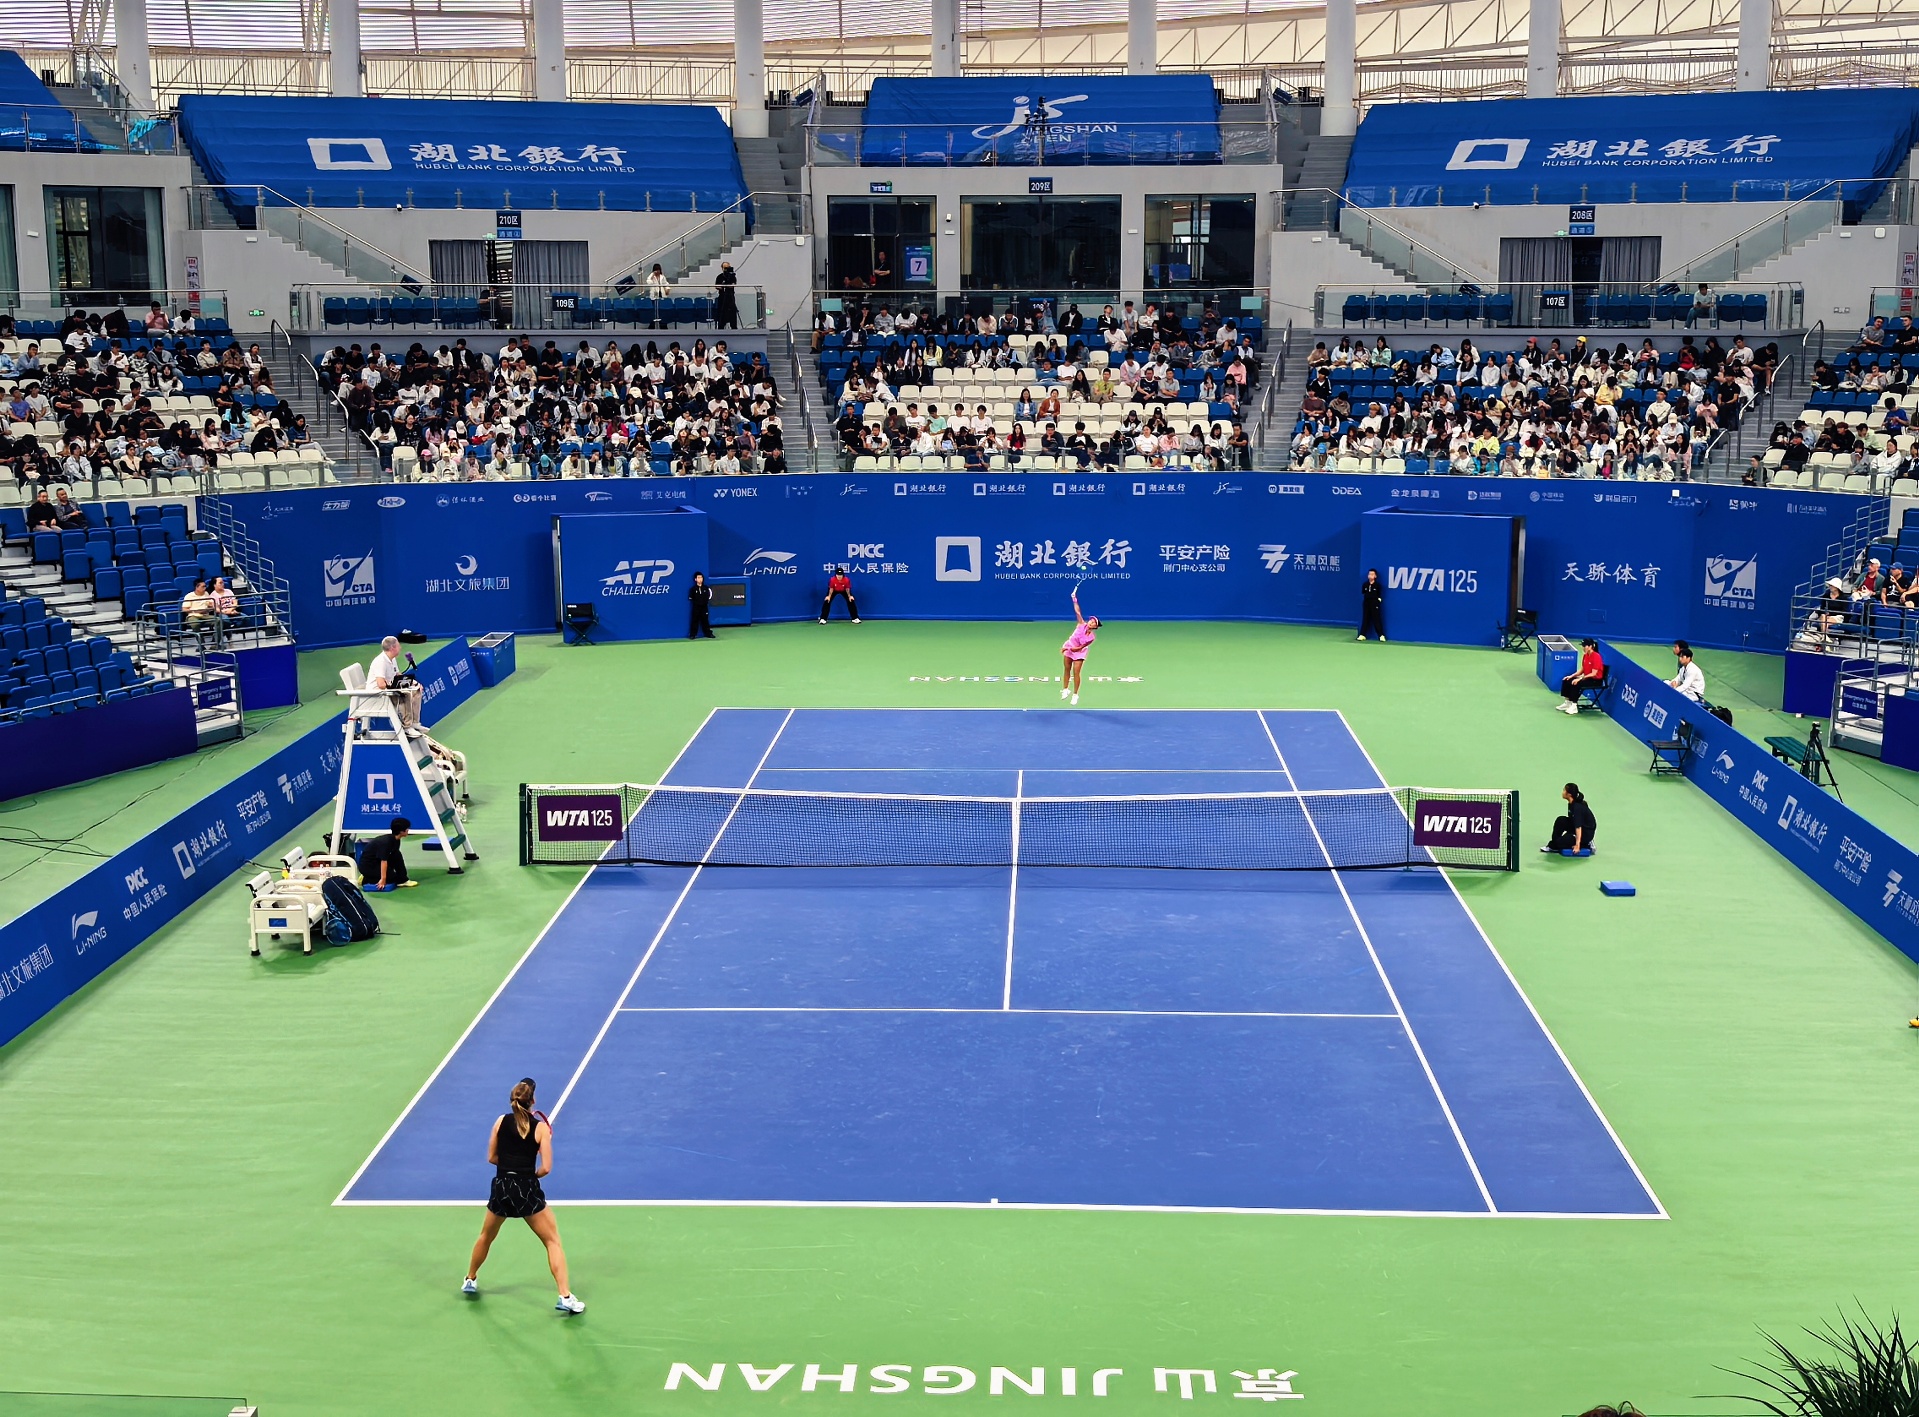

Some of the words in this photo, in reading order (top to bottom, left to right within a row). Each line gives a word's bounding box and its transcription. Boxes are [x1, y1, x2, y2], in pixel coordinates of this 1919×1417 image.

[1546, 134, 1783, 160] 湖北銀行
[409, 142, 628, 167] 湖北銀行
[415, 162, 454, 171] HUBEI
[457, 163, 493, 172] BANK
[496, 164, 585, 173] CORPORATION
[588, 165, 636, 174] LIMITED
[1541, 160, 1581, 168] HUBEI
[1584, 159, 1619, 167] BANK
[1623, 157, 1719, 167] CORPORATION
[1721, 155, 1774, 165] LIMITED
[498, 215, 519, 225] 210区
[915, 260, 922, 272] 7
[555, 298, 575, 309] 109区
[1546, 296, 1566, 307] 107区
[730, 487, 758, 498] YONEX
[1331, 486, 1362, 496] ODEA
[847, 543, 885, 559] PICC
[994, 538, 1133, 569] 湖北銀行
[1158, 544, 1231, 561] 平安产险
[1293, 553, 1341, 566] 天顺风能
[598, 559, 675, 586] ATP
[743, 565, 797, 577] LI-NING
[822, 562, 909, 574] 中国人民保险
[1163, 563, 1226, 573] 荆门中心支公司
[1293, 564, 1316, 572] TITAN
[994, 572, 1018, 580] HUBEI
[1019, 572, 1041, 580] BANK
[1043, 572, 1099, 580] CORPORATION
[1100, 572, 1131, 580] LIMITED
[1388, 566, 1445, 592] WTA
[1448, 569, 1478, 593] 125
[1561, 561, 1661, 590] 天骄体育
[351, 582, 374, 593] CTA
[425, 576, 510, 593] 湖北文旅集团
[601, 584, 670, 597] CHALLENGER
[1732, 586, 1754, 599] CTA
[325, 596, 376, 608] 中国网球协会
[1703, 596, 1755, 610] 中国网球协会
[546, 809, 590, 827] WTA
[590, 809, 613, 827] 125
[1423, 815, 1467, 834] WTA
[1469, 816, 1493, 834] 125
[124, 866, 150, 895] PICC
[75, 926, 107, 956] LI-NING
[663, 1361, 1124, 1397] JINGSHAN
[1154, 1366, 1305, 1402] 京山
